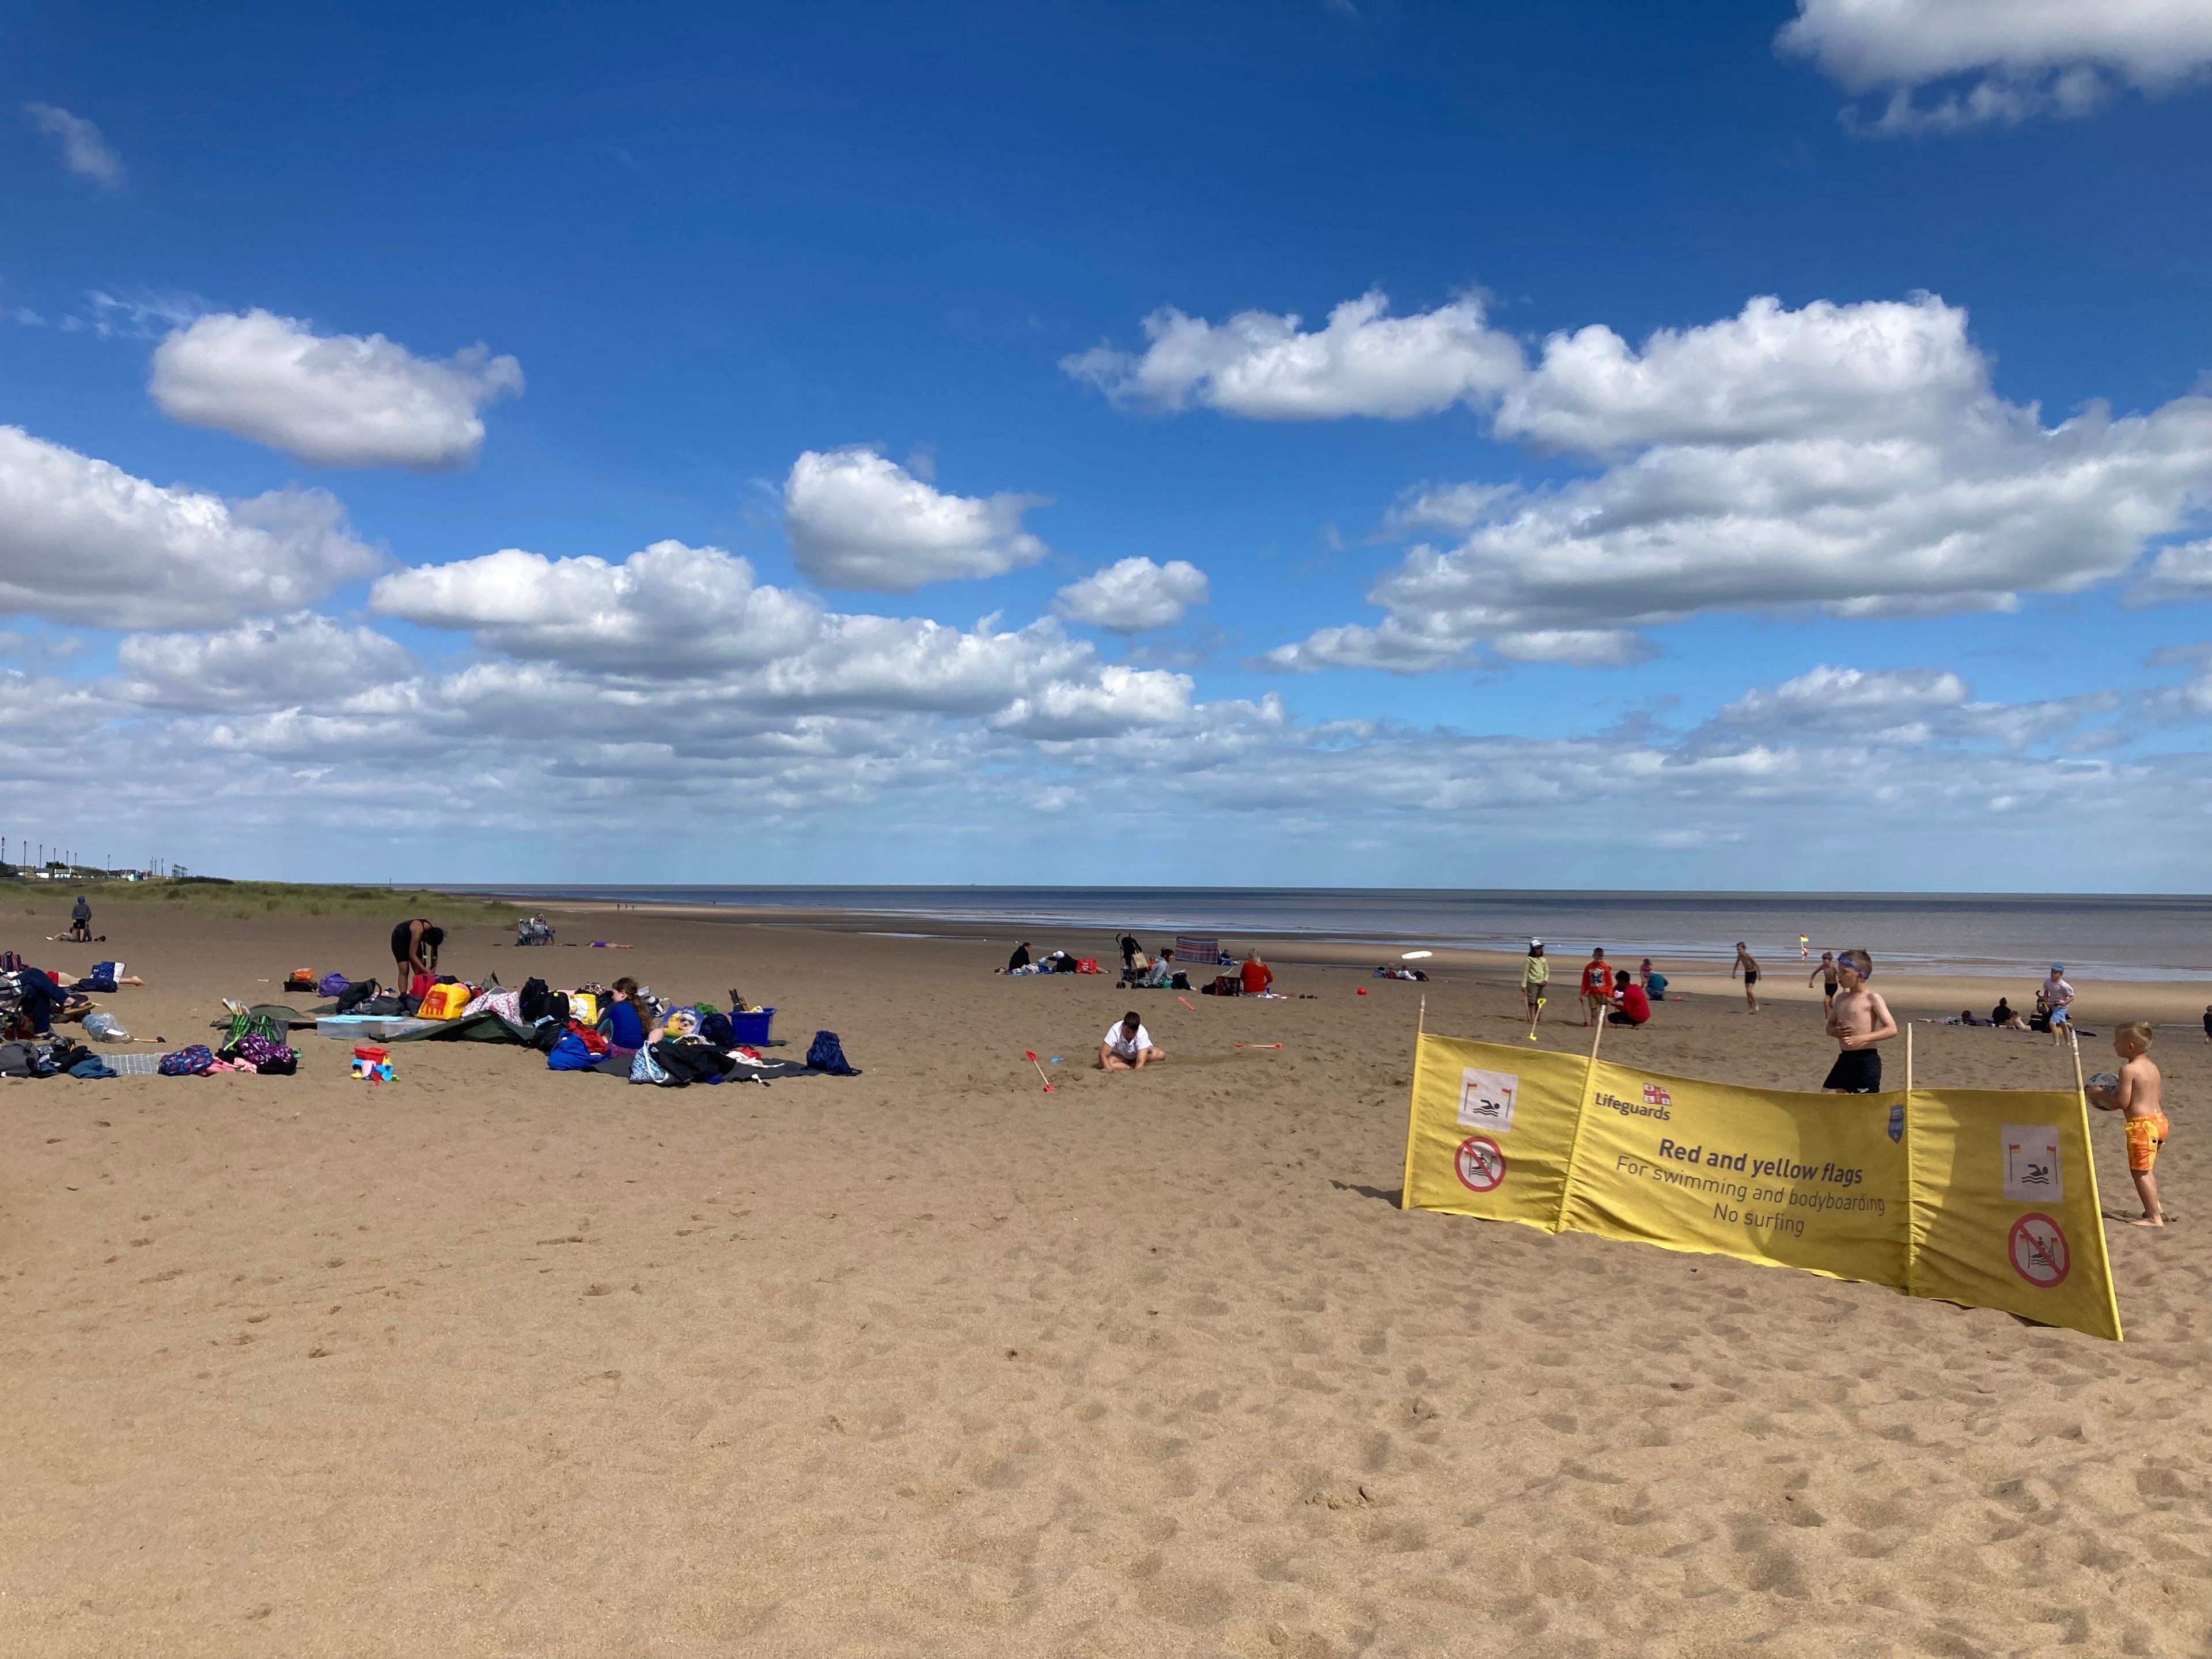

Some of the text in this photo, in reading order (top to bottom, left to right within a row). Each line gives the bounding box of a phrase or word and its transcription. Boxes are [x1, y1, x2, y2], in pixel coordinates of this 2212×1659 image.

[1595, 1092, 1671, 1120] Lifeguards
[1659, 1138, 1863, 1187] Red and yellow flags
[1616, 1156, 1885, 1217] For swimming and bodyboarding
[1714, 1202, 1804, 1237] No surfing
